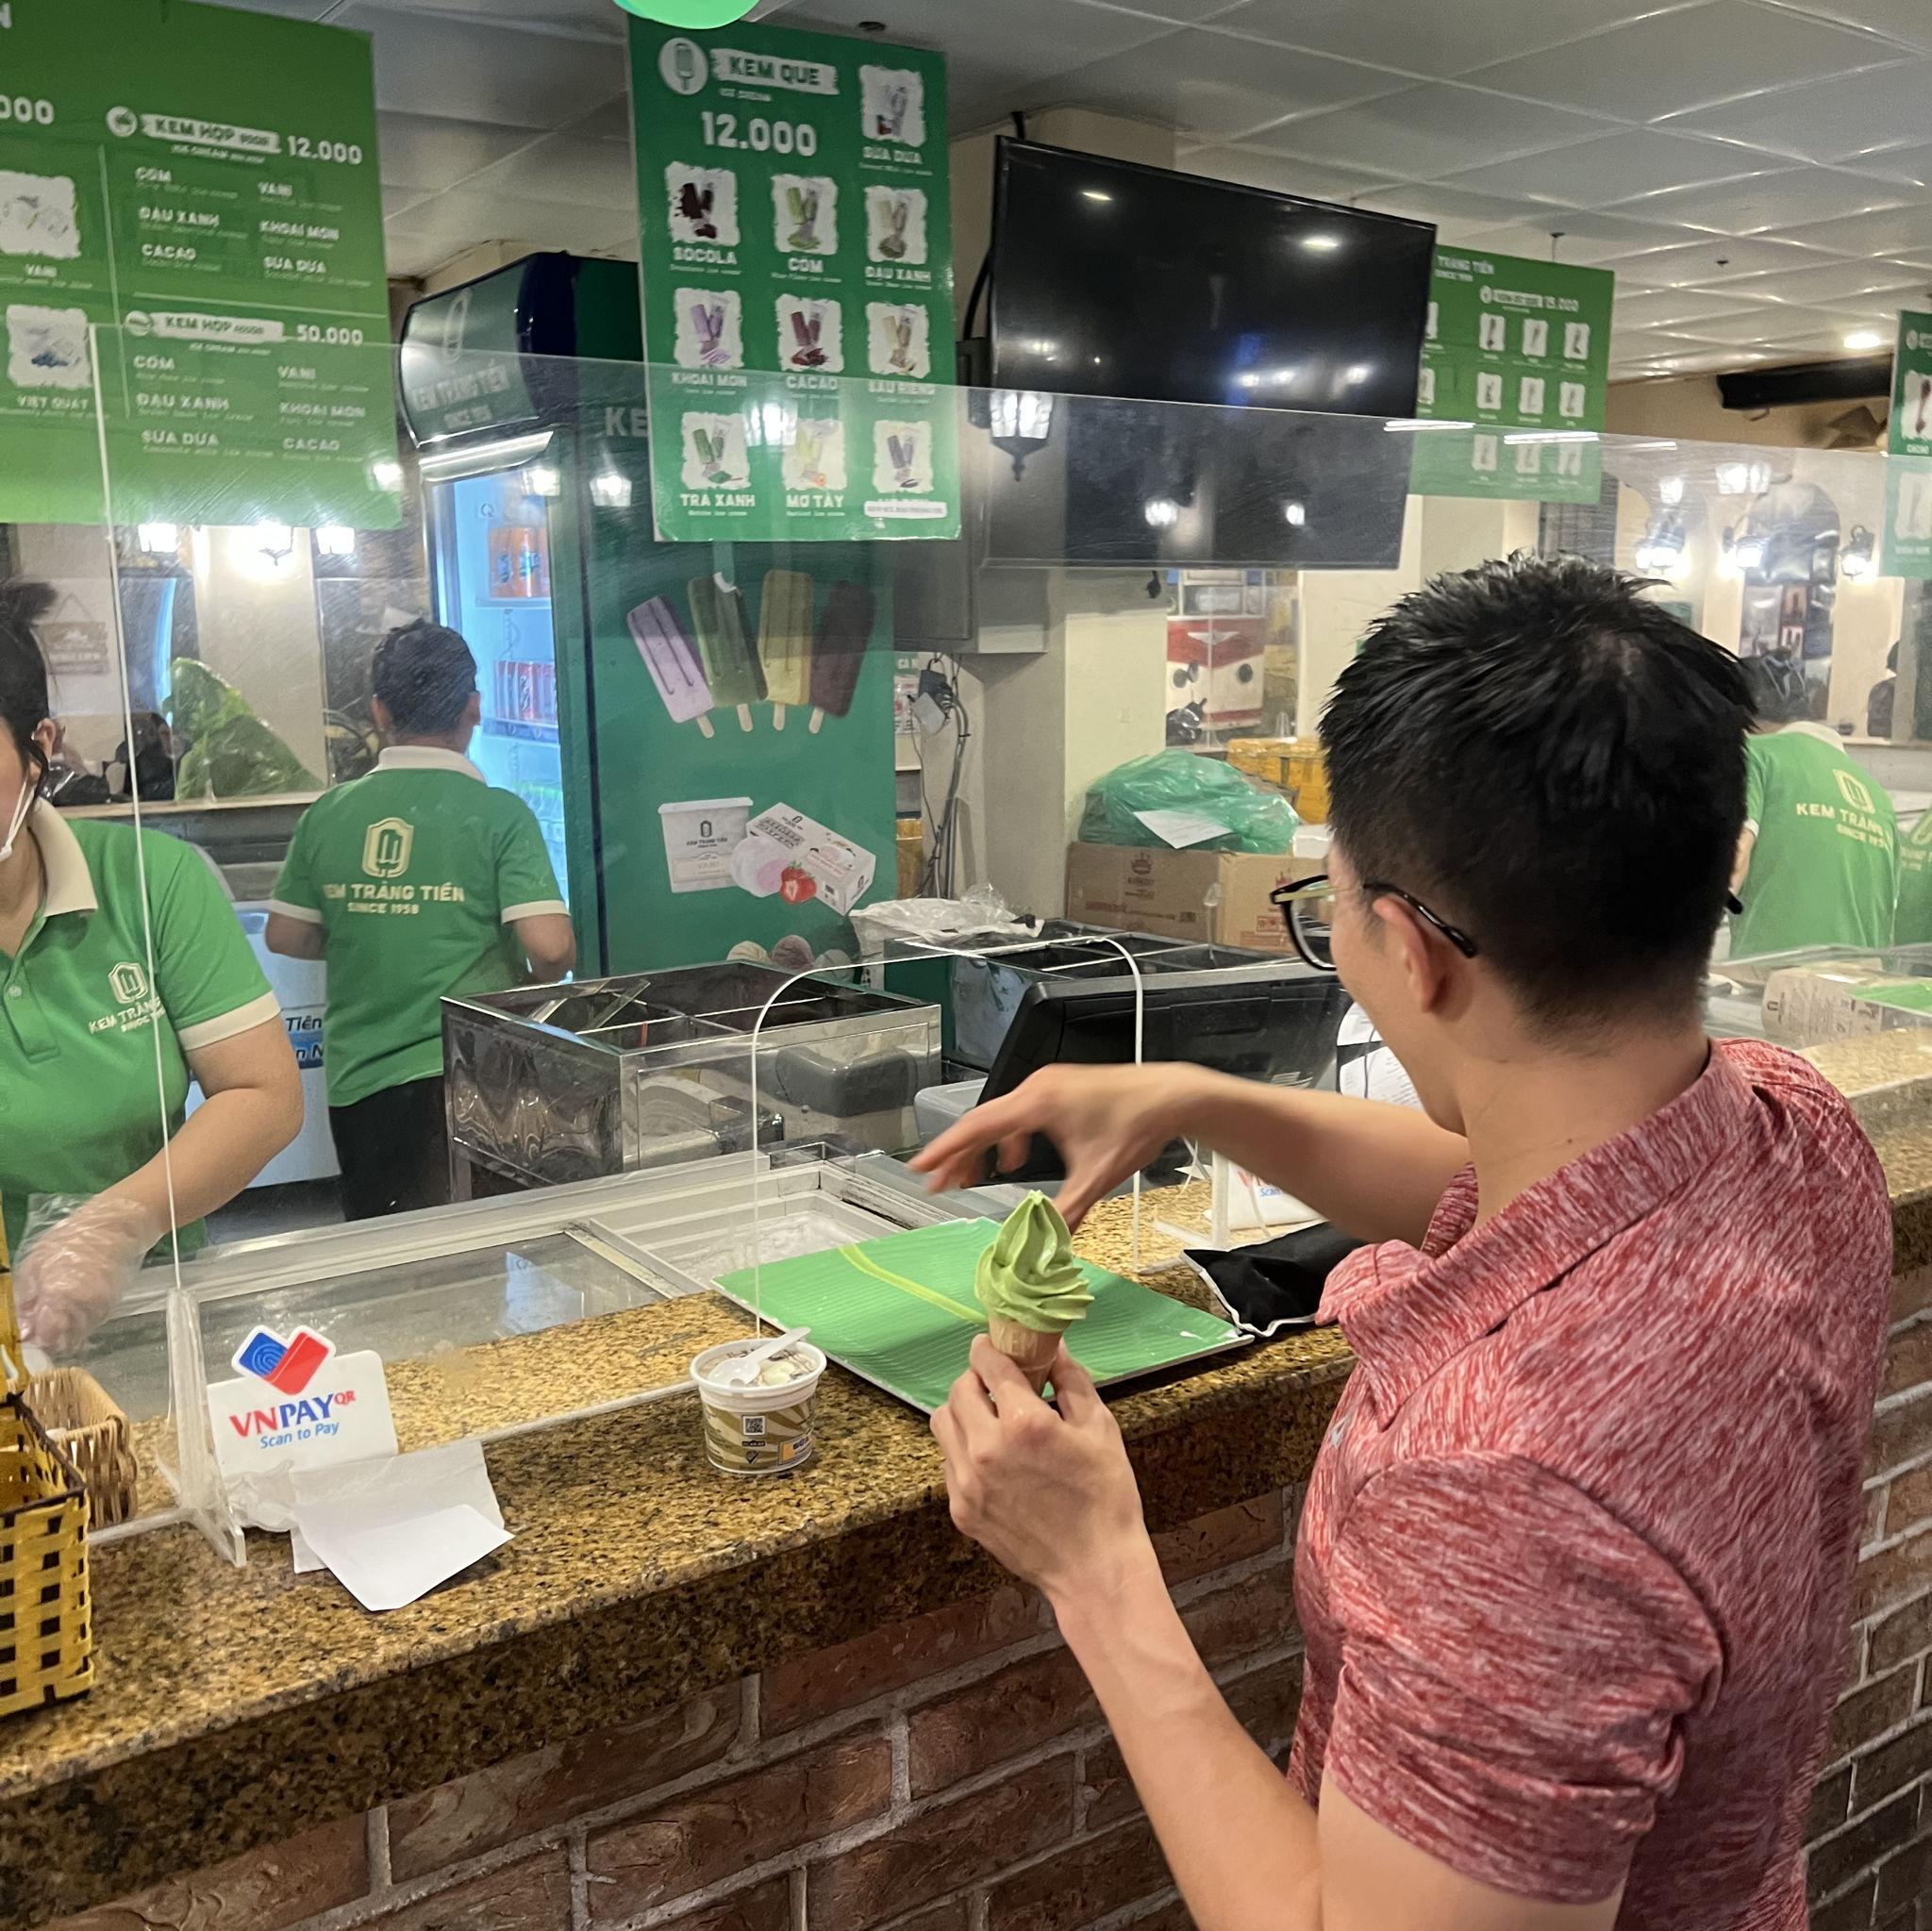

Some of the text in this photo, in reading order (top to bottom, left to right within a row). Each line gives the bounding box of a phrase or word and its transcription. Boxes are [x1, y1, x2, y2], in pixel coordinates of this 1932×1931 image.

[728, 57, 821, 85] KEM QUE
[155, 118, 195, 135] KEM
[701, 111, 817, 157] 12.000
[288, 135, 362, 165] 12.000
[296, 324, 363, 347] 50.000
[1796, 802, 1836, 820] KEM
[347, 902, 388, 913] SINCE
[89, 1014, 117, 1034] KEM
[259, 1423, 340, 1449] Scan to Pay
